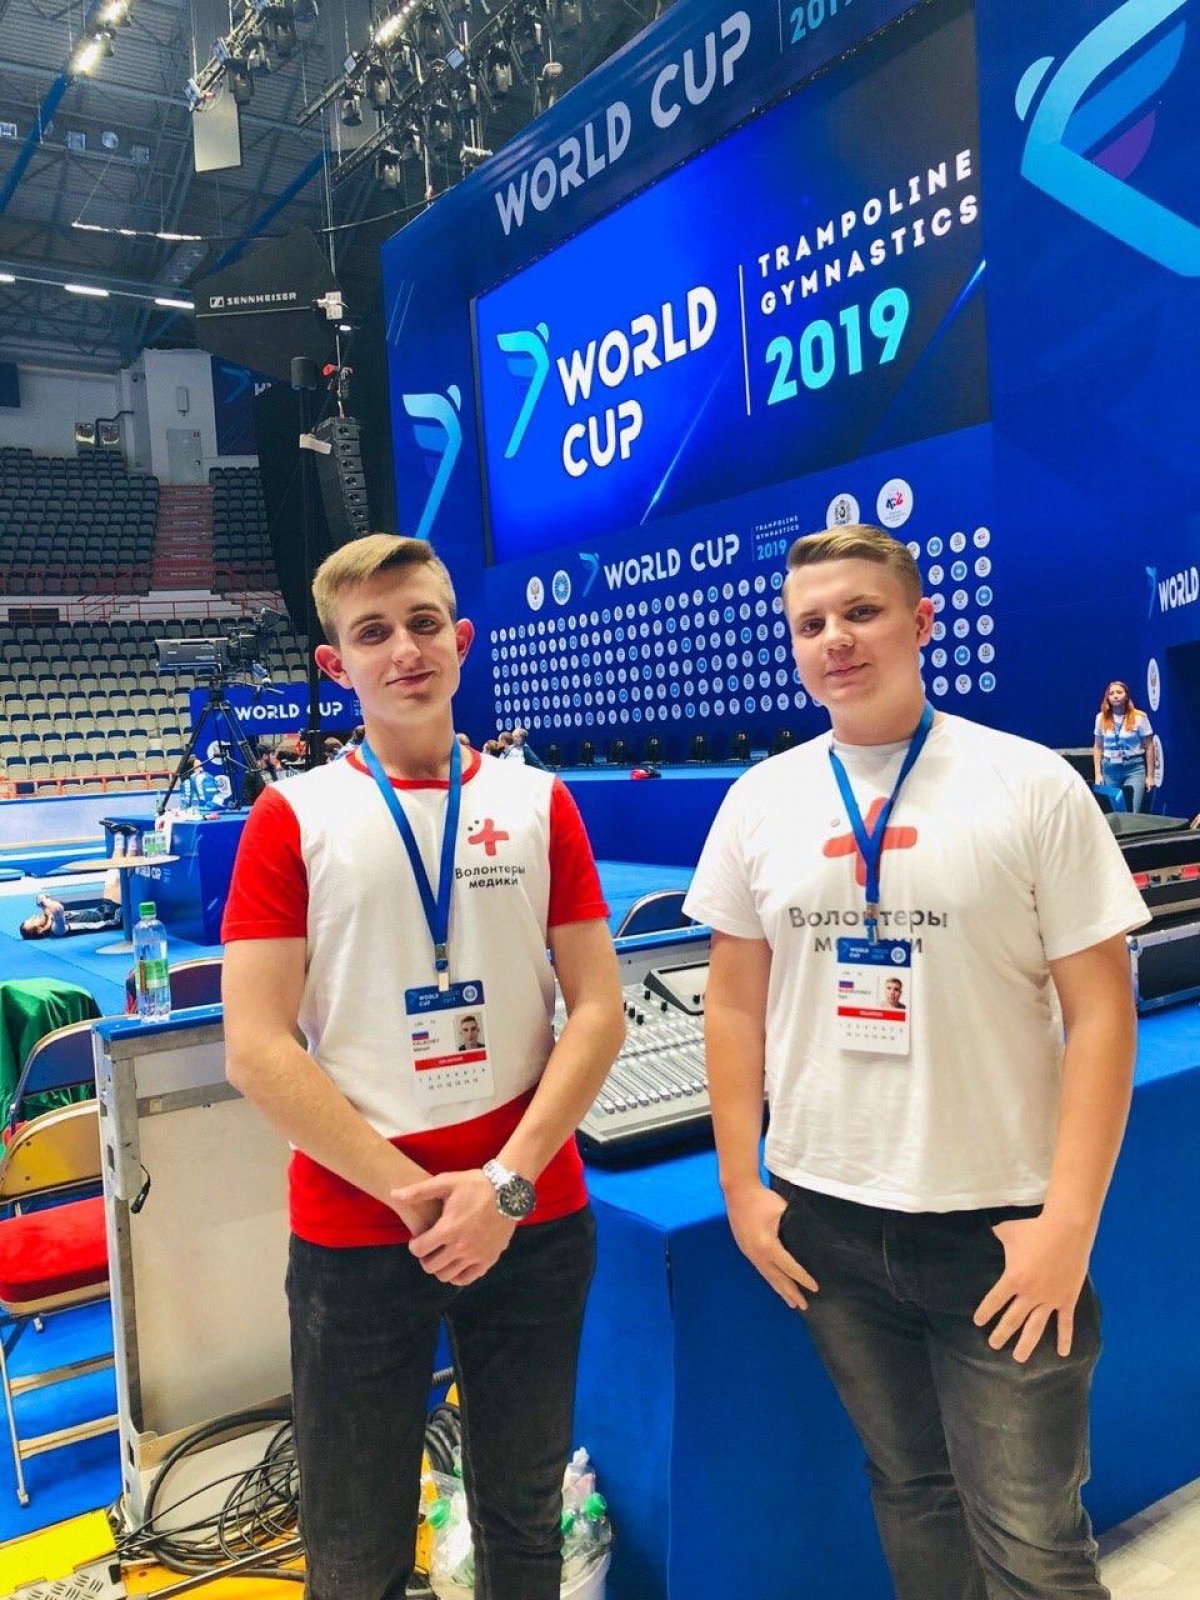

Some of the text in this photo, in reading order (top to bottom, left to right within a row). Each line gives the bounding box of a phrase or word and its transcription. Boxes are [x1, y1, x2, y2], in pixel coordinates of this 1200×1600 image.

[790, 0, 852, 44] 201
[495, 11, 751, 235] WORLD CUP
[758, 149, 972, 277] TRAMPOLINE
[761, 195, 978, 314] GYMNASTICS
[226, 291, 297, 306] SENNHEISER
[556, 286, 718, 406] WORLD
[765, 287, 910, 406] 2019
[562, 399, 644, 478] CUP
[603, 533, 740, 590] WORLD CUP
[757, 539, 787, 560] 2019
[1158, 566, 1200, 612] WORLD
[234, 704, 300, 720] WORLD
[306, 701, 343, 716] UP
[455, 865, 526, 880] Волонтеры
[469, 877, 518, 890] медики
[788, 907, 949, 933] Волотеры
